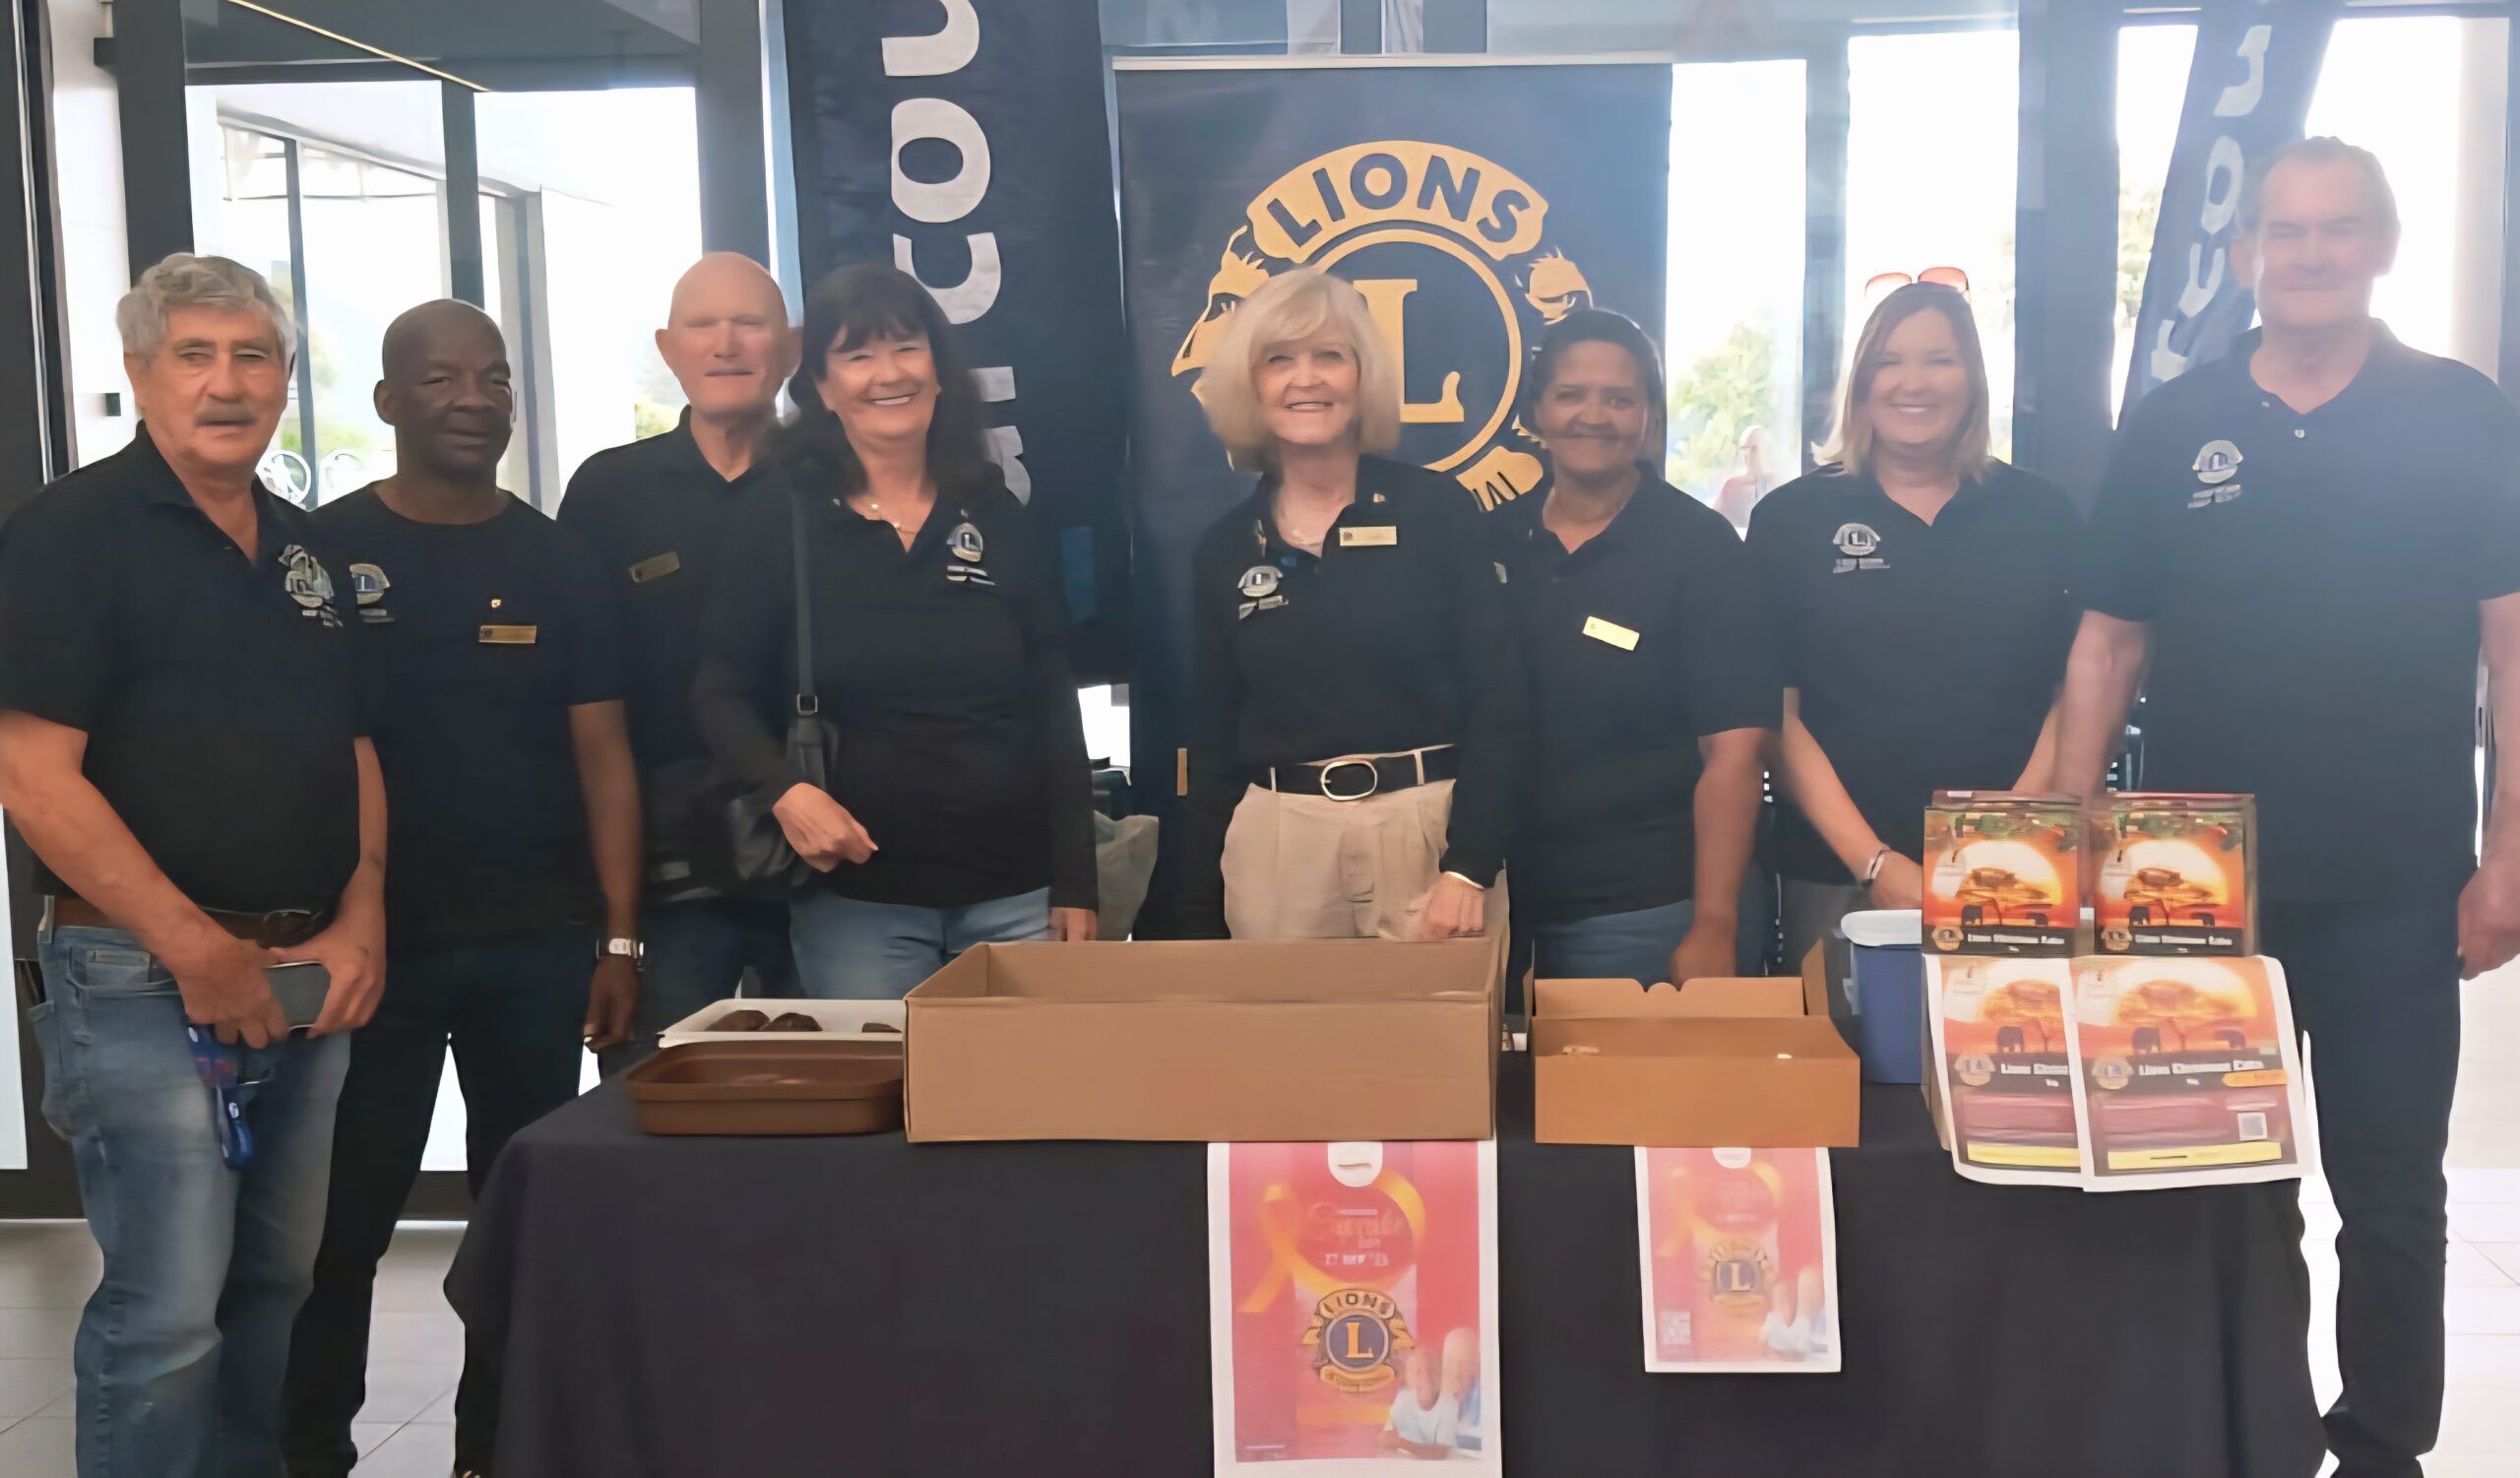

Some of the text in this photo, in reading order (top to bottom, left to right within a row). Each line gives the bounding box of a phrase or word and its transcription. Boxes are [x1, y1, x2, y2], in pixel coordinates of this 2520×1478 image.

[1266, 153, 1531, 248] LIONS
[1353, 279, 1465, 423] L
[1346, 1321, 1374, 1358] L
